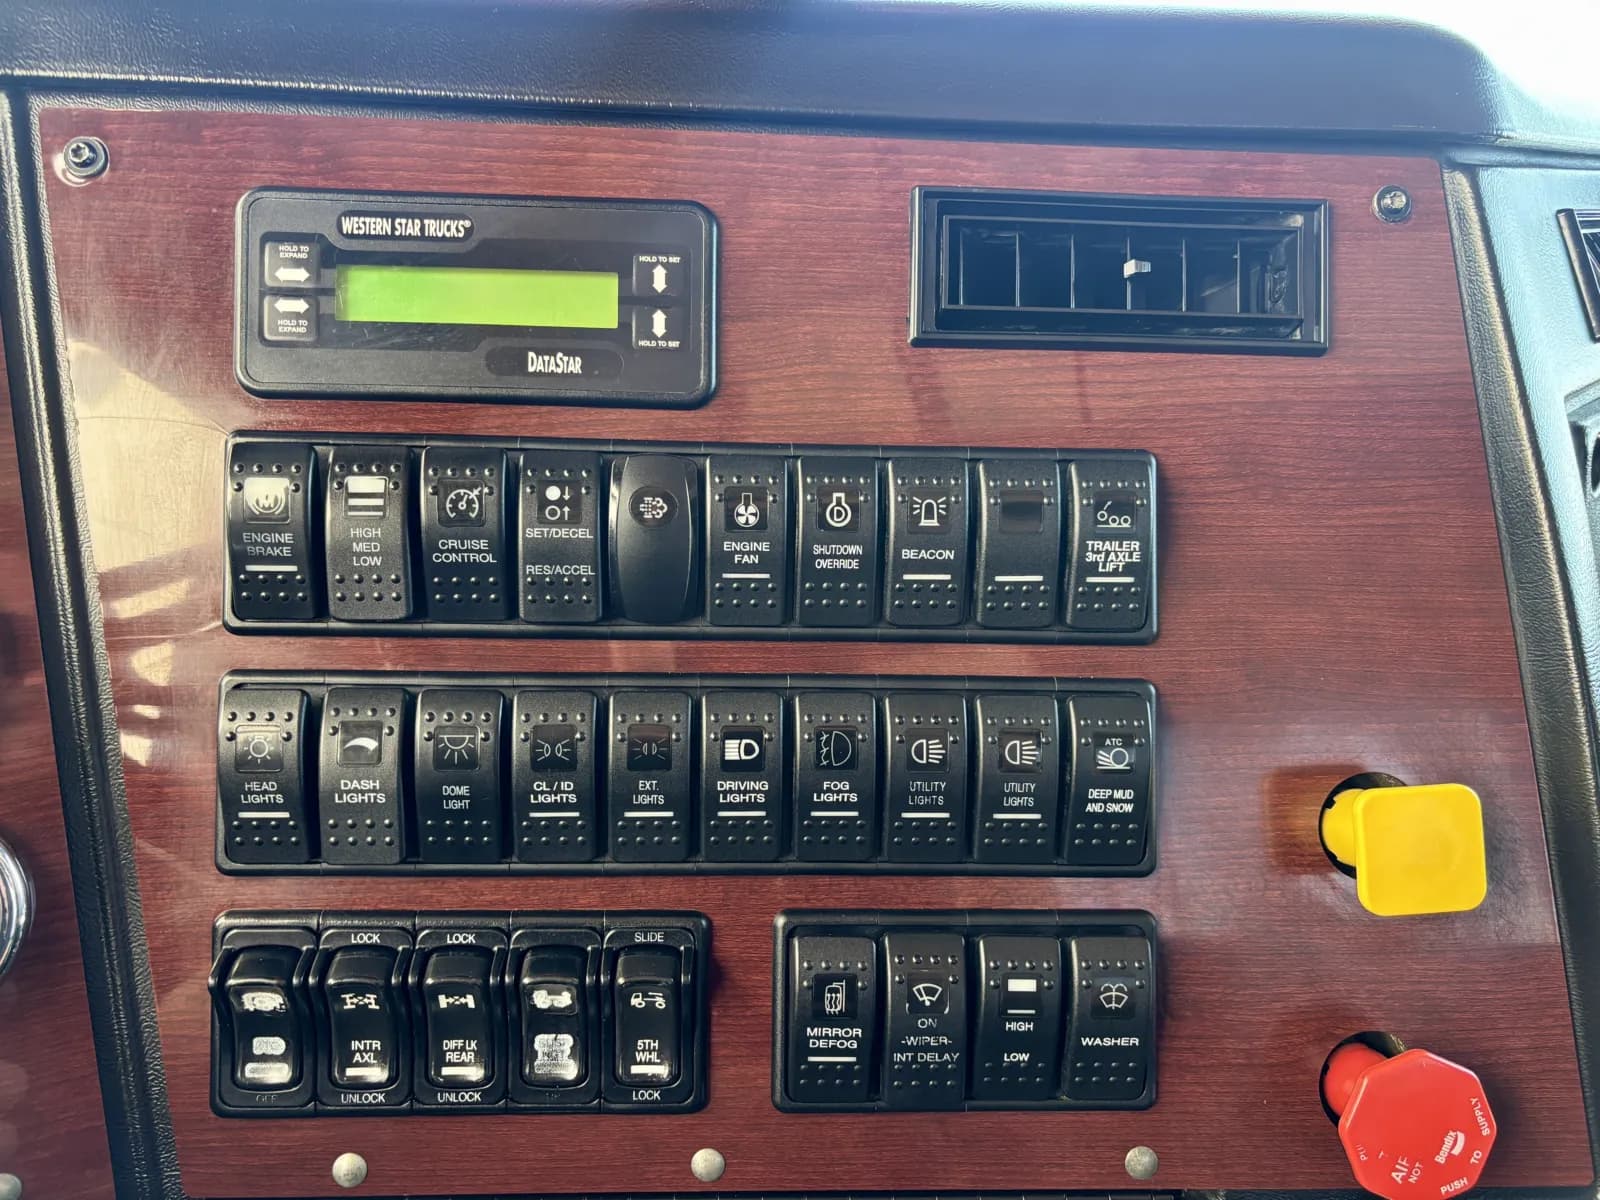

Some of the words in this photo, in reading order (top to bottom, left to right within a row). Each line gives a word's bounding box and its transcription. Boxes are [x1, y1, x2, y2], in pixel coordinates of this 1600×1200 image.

[341, 216, 391, 236] WESTERN
[394, 218, 421, 237] STAR
[243, 532, 294, 544] ENGINE
[350, 528, 381, 539] HIGH
[526, 528, 594, 539] SET/DECEL
[353, 542, 381, 553] MED
[438, 539, 489, 550] CRUISE
[723, 541, 770, 552] ENGINE
[813, 544, 863, 556] SHUTDOWN
[1086, 541, 1140, 552] TRAILER
[247, 545, 292, 557] BRAKE
[902, 549, 954, 560] BEACON
[353, 556, 382, 566] LOW
[432, 552, 497, 563] CONTROL
[734, 554, 759, 564] FAN
[1086, 552, 1105, 562] 3rd
[1107, 552, 1141, 563] AXLE
[815, 559, 860, 569] OVERRIDE
[1098, 562, 1125, 573] LIFT
[526, 565, 595, 576] RES/ACCEL
[1105, 737, 1123, 746] ATC
[245, 781, 277, 792] HEAD
[340, 780, 380, 791] DASH
[442, 785, 470, 796] DOME
[638, 780, 659, 791] EXT.
[717, 781, 769, 791] DRIVING
[823, 781, 850, 791] FOG
[909, 781, 946, 793] UTILITY
[1004, 783, 1036, 793] UTILITY
[241, 793, 284, 804] LIGHTS
[335, 793, 386, 804] LIGHTS
[530, 793, 577, 804] LIGHTS
[633, 794, 665, 805] LIGHTS
[719, 793, 766, 803] LIGHTS
[813, 792, 858, 803] LIGHTS
[1088, 789, 1111, 799] DEEP
[1113, 789, 1134, 799] MUD
[443, 799, 470, 810] LIGHT
[908, 795, 945, 806] LIGHTS
[1003, 796, 1035, 807] LIGHTS
[1086, 802, 1104, 813] AND
[1106, 802, 1134, 813] SNOW
[351, 933, 380, 944] LOCK
[447, 933, 476, 944] LOCK
[634, 931, 664, 943] SLIDE
[917, 1018, 938, 1029] ON
[1005, 1021, 1034, 1031] HIGH
[806, 1027, 862, 1038] MIRROR
[351, 1040, 381, 1051] INTR
[443, 1040, 462, 1050] DIFF
[465, 1040, 477, 1050] LK
[637, 1040, 659, 1050] 5TH
[809, 1039, 858, 1049] DEFOG
[1081, 1037, 1139, 1046] WASHER
[352, 1052, 377, 1063] AXL
[446, 1052, 475, 1063] REAR
[635, 1052, 661, 1062] WHL
[893, 1053, 914, 1063] INT
[917, 1053, 960, 1063] DELAY
[1003, 1053, 1030, 1062] LOW
[341, 1092, 385, 1104] UNLOCK
[437, 1091, 481, 1103] UNLOCK
[632, 1090, 661, 1101] LOCK
[1469, 1097, 1490, 1136] SUPPLY
[1434, 1130, 1458, 1164] Bendix
[1470, 1150, 1482, 1164] TO
[1408, 1161, 1424, 1184] NOT
[1440, 1177, 1468, 1195] PUSH
